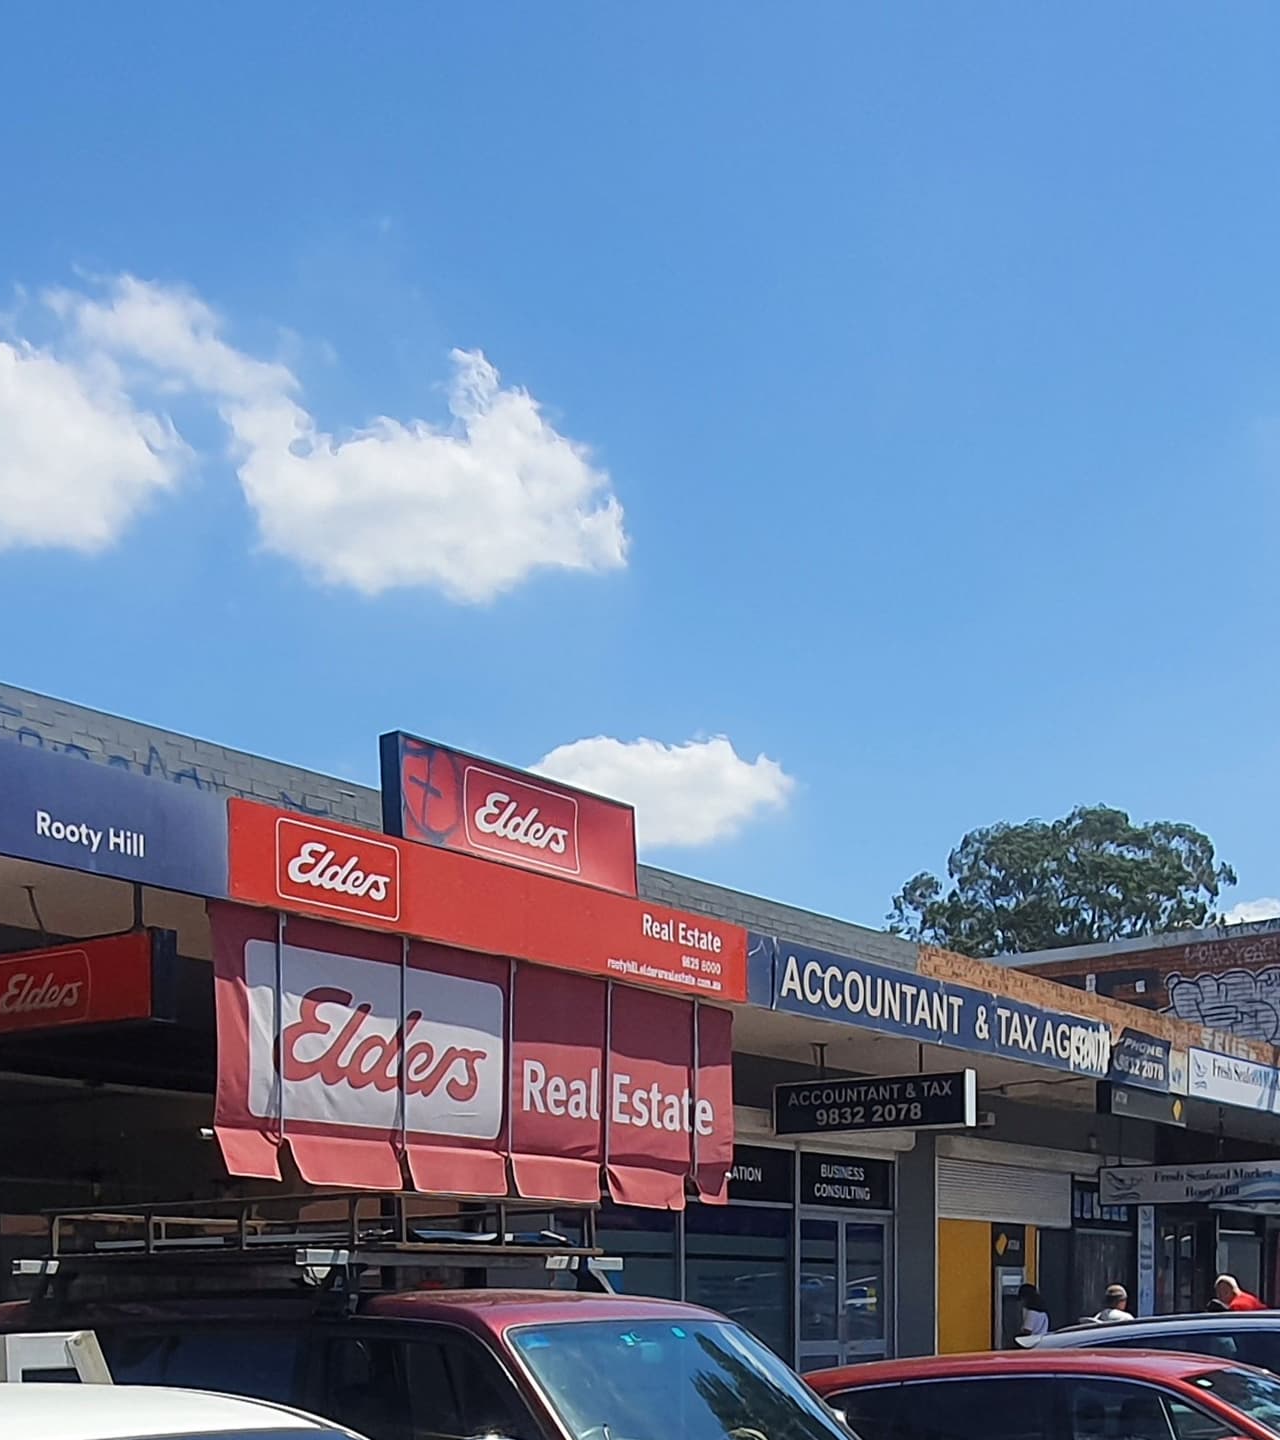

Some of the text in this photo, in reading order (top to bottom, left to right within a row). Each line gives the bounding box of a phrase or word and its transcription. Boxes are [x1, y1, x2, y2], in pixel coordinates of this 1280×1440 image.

[36, 810, 145, 858] Rooty Hill
[474, 792, 568, 854] Elders
[288, 842, 391, 901] Elders
[642, 913, 722, 953] Real Estate
[780, 955, 963, 1035] ACCOUNTANT
[974, 1004, 990, 1041] &
[996, 1007, 1038, 1053] TAX
[274, 986, 487, 1102] Elders
[1123, 1036, 1164, 1058] PHONE
[1142, 1060, 1165, 1081] 2078
[522, 1058, 715, 1136] Real Estate
[788, 1079, 952, 1107] ACCOUNTANT & TAX
[816, 1102, 922, 1126] 9832 2078
[731, 1164, 762, 1183] ATION
[820, 1163, 865, 1181] BUSINESS
[814, 1182, 870, 1201] CONSULTING
